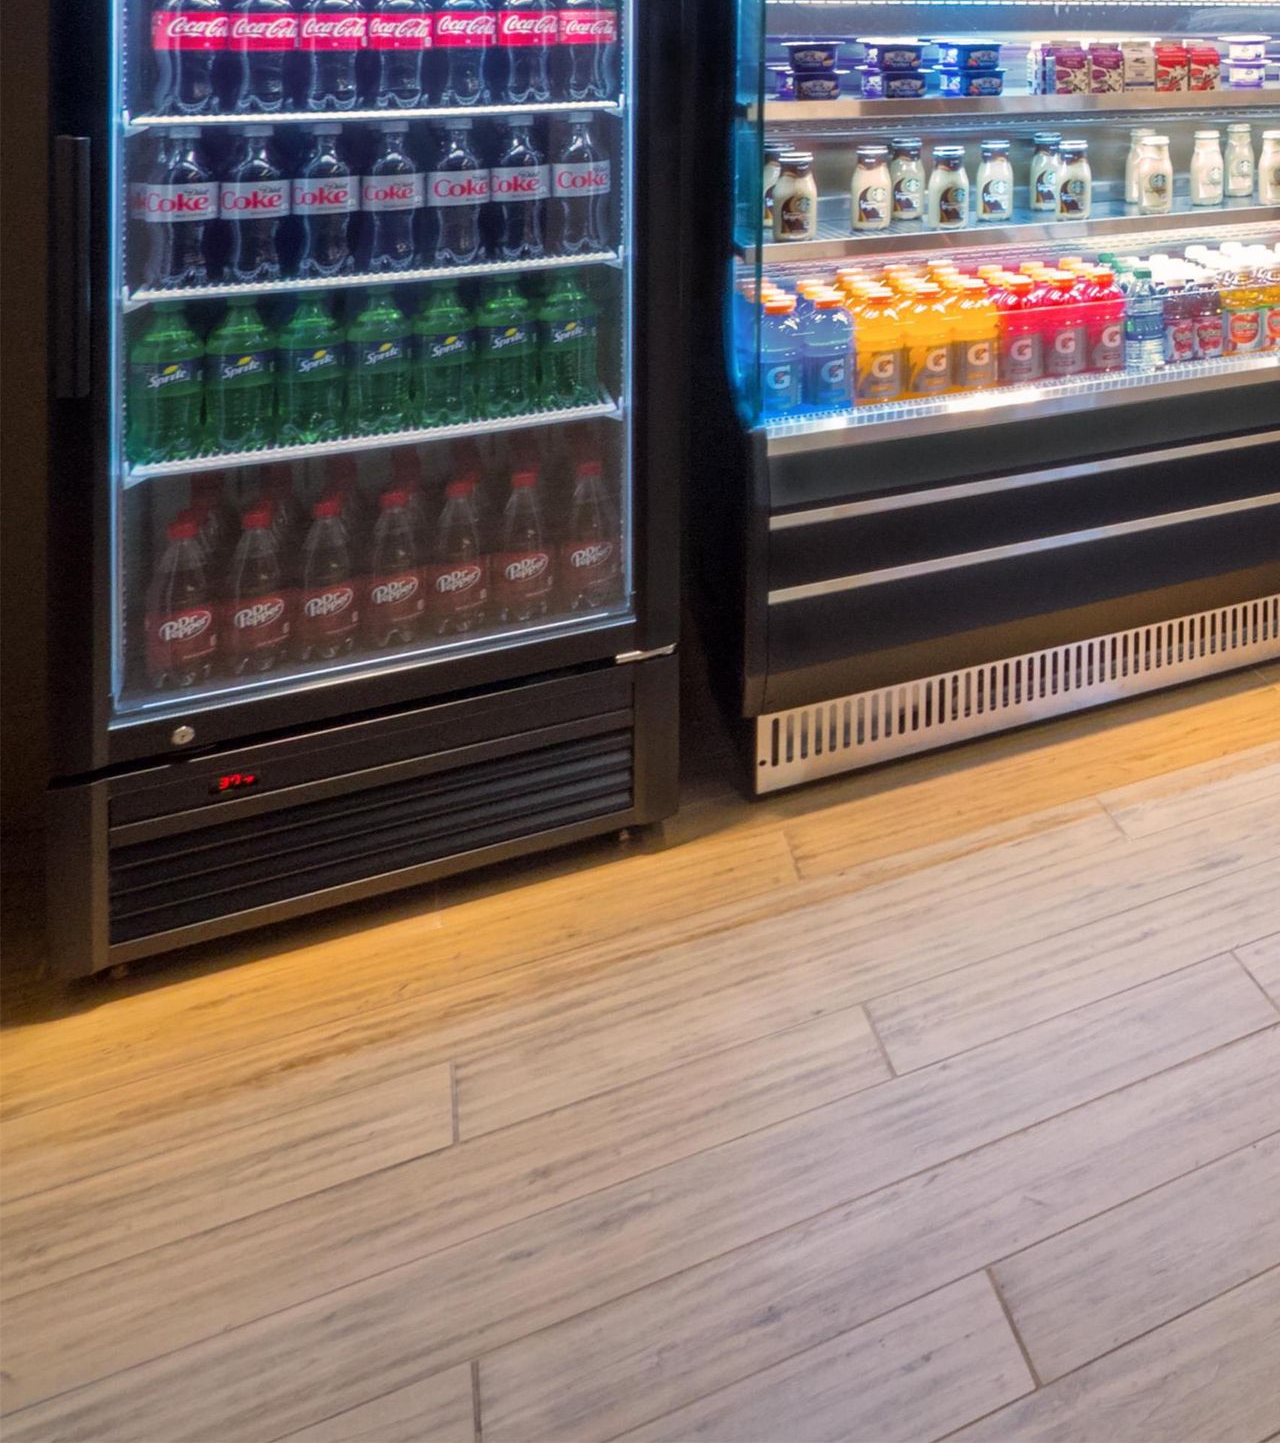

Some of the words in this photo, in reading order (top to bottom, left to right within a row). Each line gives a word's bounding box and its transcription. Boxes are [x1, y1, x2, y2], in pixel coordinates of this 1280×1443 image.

[302, 17, 366, 38] Coca-Cola
[369, 17, 428, 38] Coca-Cola
[437, 15, 496, 35] Coca-Cola
[434, 178, 488, 198] Coke
[557, 170, 608, 189] Coke
[220, 190, 282, 211] Coke
[363, 182, 413, 201] Coke
[146, 192, 209, 212] Coke
[491, 332, 524, 349] Sprite
[552, 326, 583, 343] Sprite
[364, 347, 398, 364] Sprite
[430, 340, 464, 357] Sprite
[220, 361, 259, 379] Sprite
[297, 354, 333, 372] Sprite
[147, 370, 188, 388] Sprite
[574, 547, 611, 568] Pepper
[583, 545, 602, 557] Dr
[507, 559, 545, 581] Pepper
[519, 557, 538, 570] Dr
[439, 571, 478, 593] Pepper
[451, 569, 469, 582] Dr
[374, 581, 415, 604] Pepper
[387, 580, 405, 592] Dr
[307, 594, 350, 617] Pepper
[320, 592, 340, 603] Dr
[237, 606, 281, 628] Pepper
[252, 603, 271, 615] Dr
[163, 617, 208, 642] Pepper
[178, 615, 197, 628] Dr
